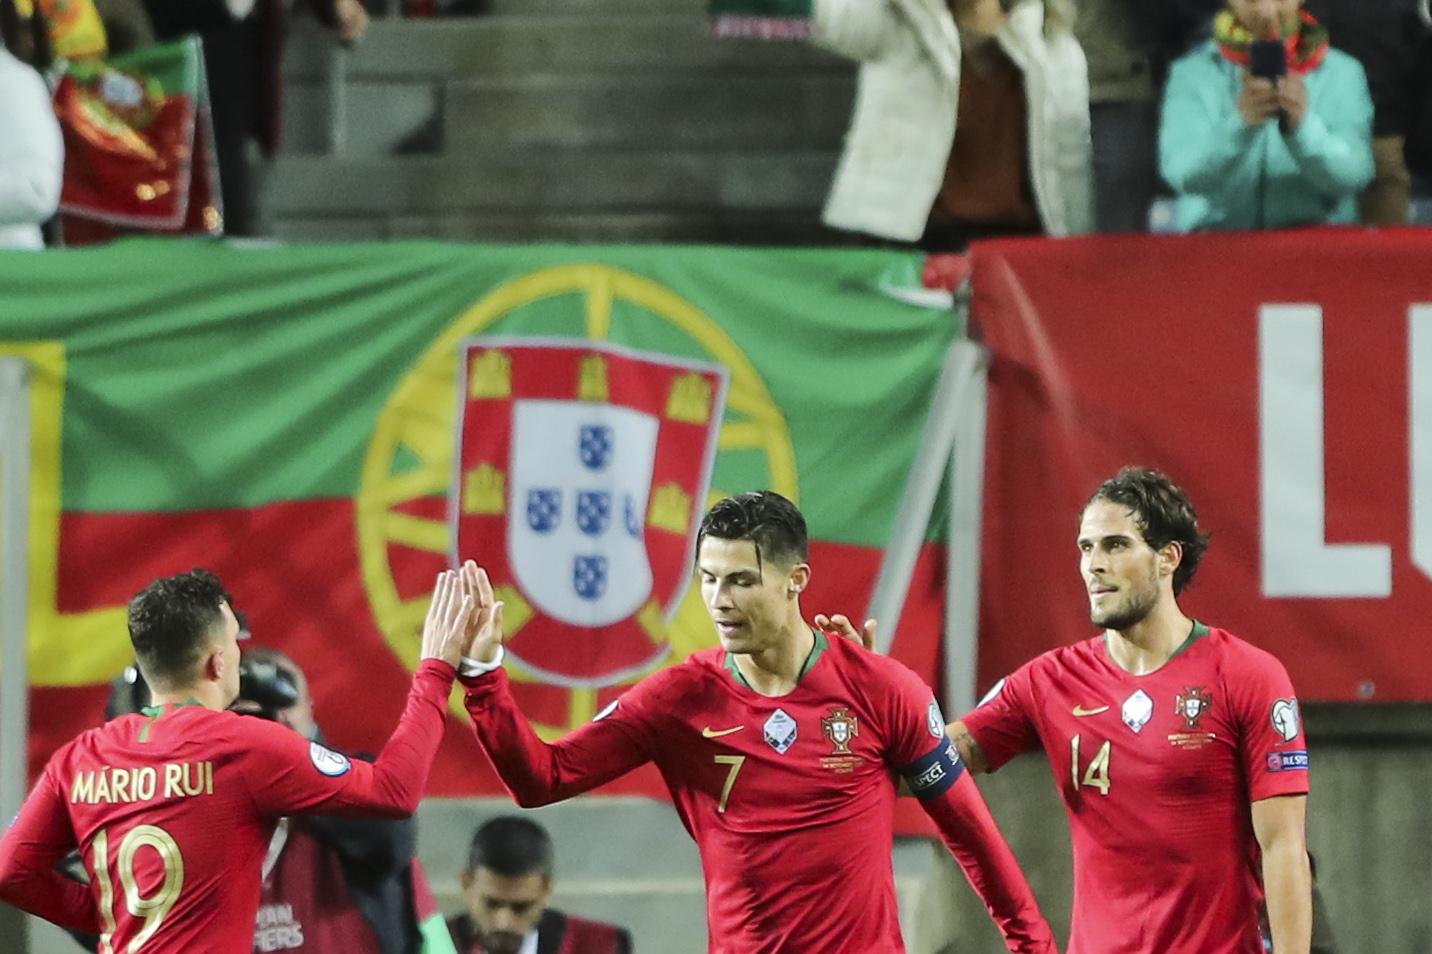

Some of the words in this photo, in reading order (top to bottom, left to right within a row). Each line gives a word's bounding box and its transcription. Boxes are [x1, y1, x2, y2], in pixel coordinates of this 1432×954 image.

[71, 766, 156, 804] MÁRIO
[164, 761, 214, 798] RUI
[714, 755, 746, 813] 7
[1071, 733, 1111, 796] 14
